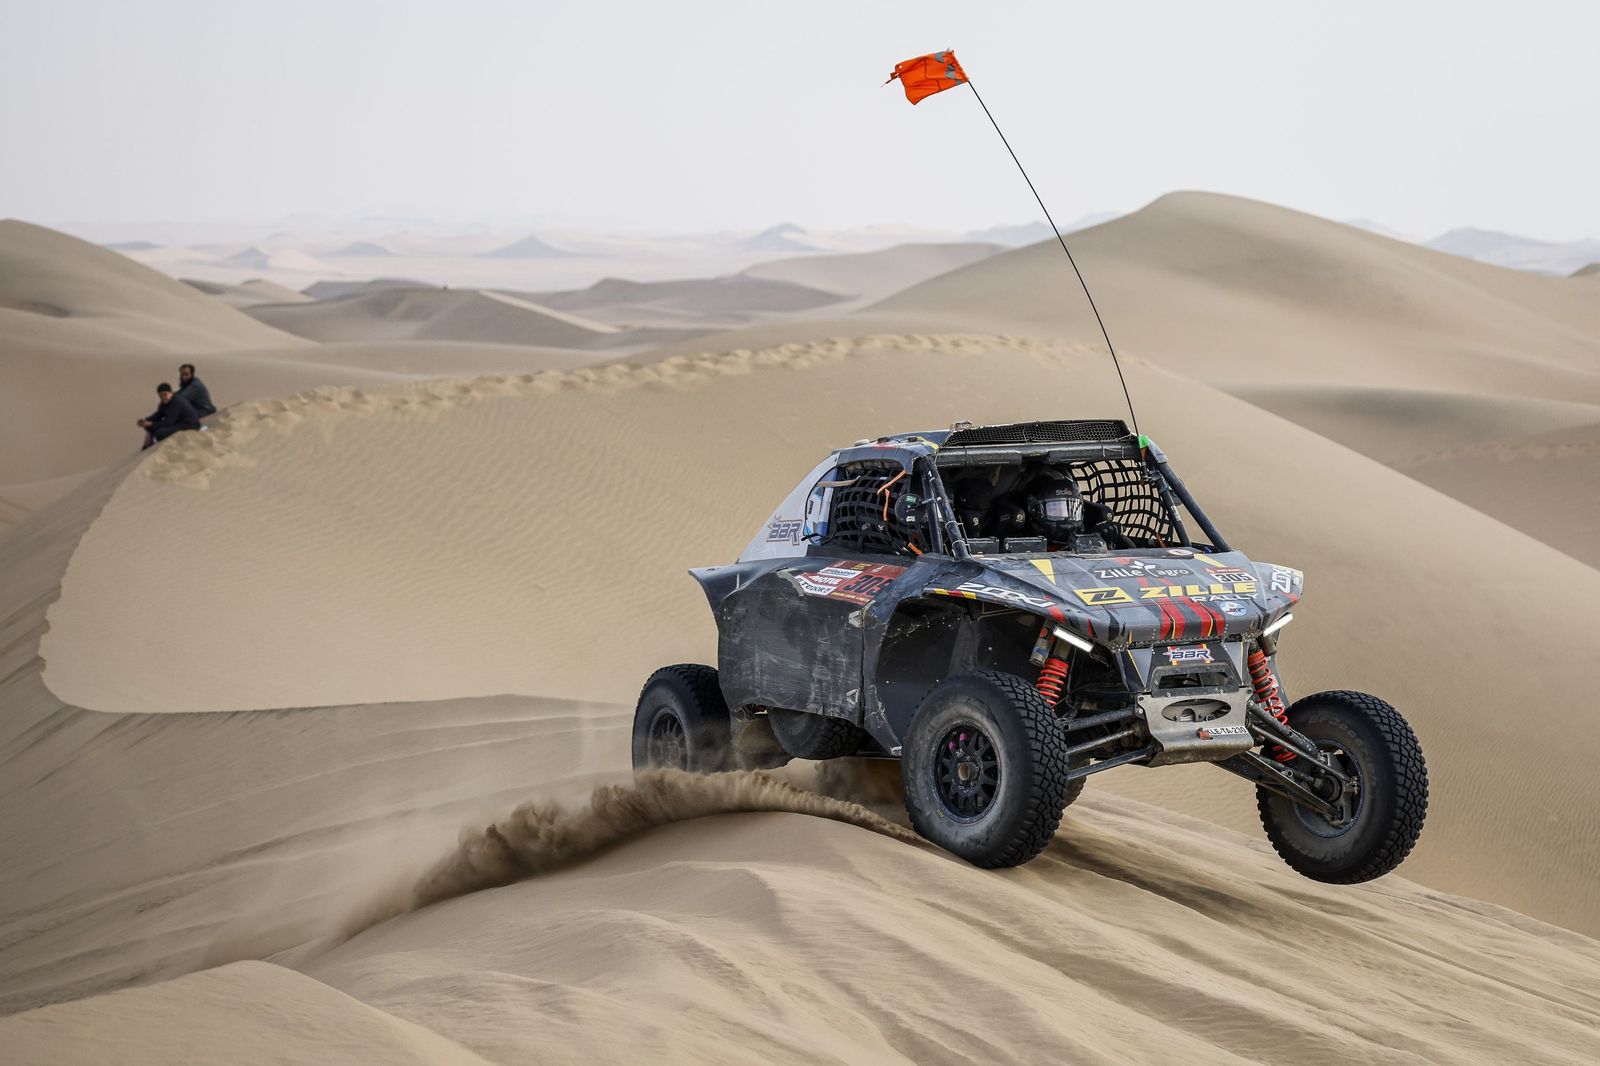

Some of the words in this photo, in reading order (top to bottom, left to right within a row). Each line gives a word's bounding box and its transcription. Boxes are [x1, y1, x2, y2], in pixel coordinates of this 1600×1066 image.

[1094, 566, 1144, 579] Zille
[1157, 568, 1190, 578] agro
[1215, 573, 1252, 582] 305
[1139, 583, 1258, 599] ZILLE
[1191, 593, 1259, 603] RALLY
[1172, 650, 1210, 659] BBR
